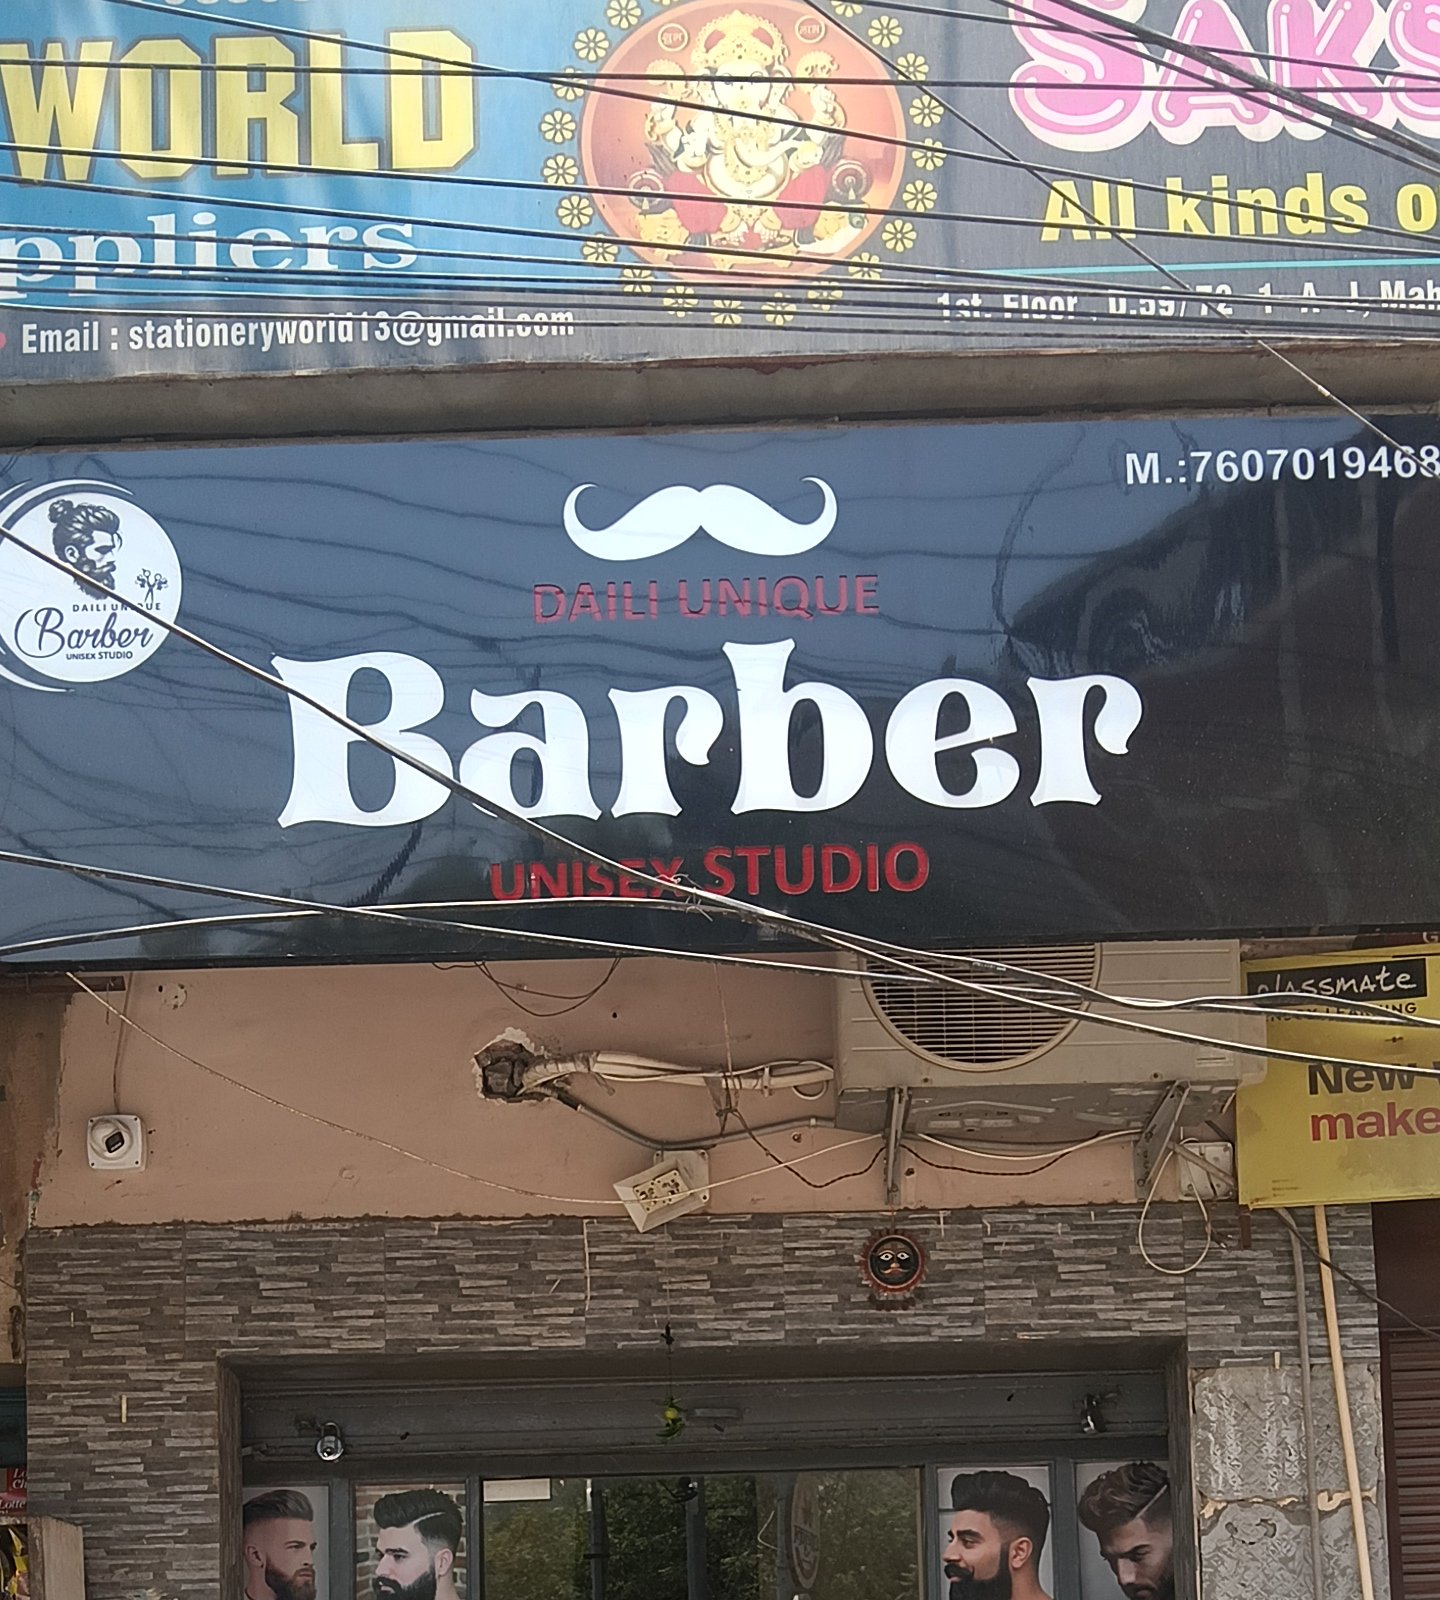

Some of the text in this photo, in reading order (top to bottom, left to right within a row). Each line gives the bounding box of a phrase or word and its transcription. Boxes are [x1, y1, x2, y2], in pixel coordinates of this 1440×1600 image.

[0, 28, 477, 183] WORLD
[1041, 173, 1440, 241] All kinds o
[22, 322, 99, 354] Email
[129, 307, 574, 352] stationeryworld13@gmail.com
[1003, 293, 1078, 320] Floor
[72, 602, 161, 612] DAILI UNUE
[533, 574, 881, 624] DAILI UNIQUE
[14, 606, 154, 658] Barber
[66, 650, 133, 661] UNISEX STUDIO
[271, 637, 1143, 829] Barber
[489, 840, 930, 901] UNISEX STUDIO
[1308, 1062, 1416, 1096] New
[1311, 1101, 1440, 1141] make
